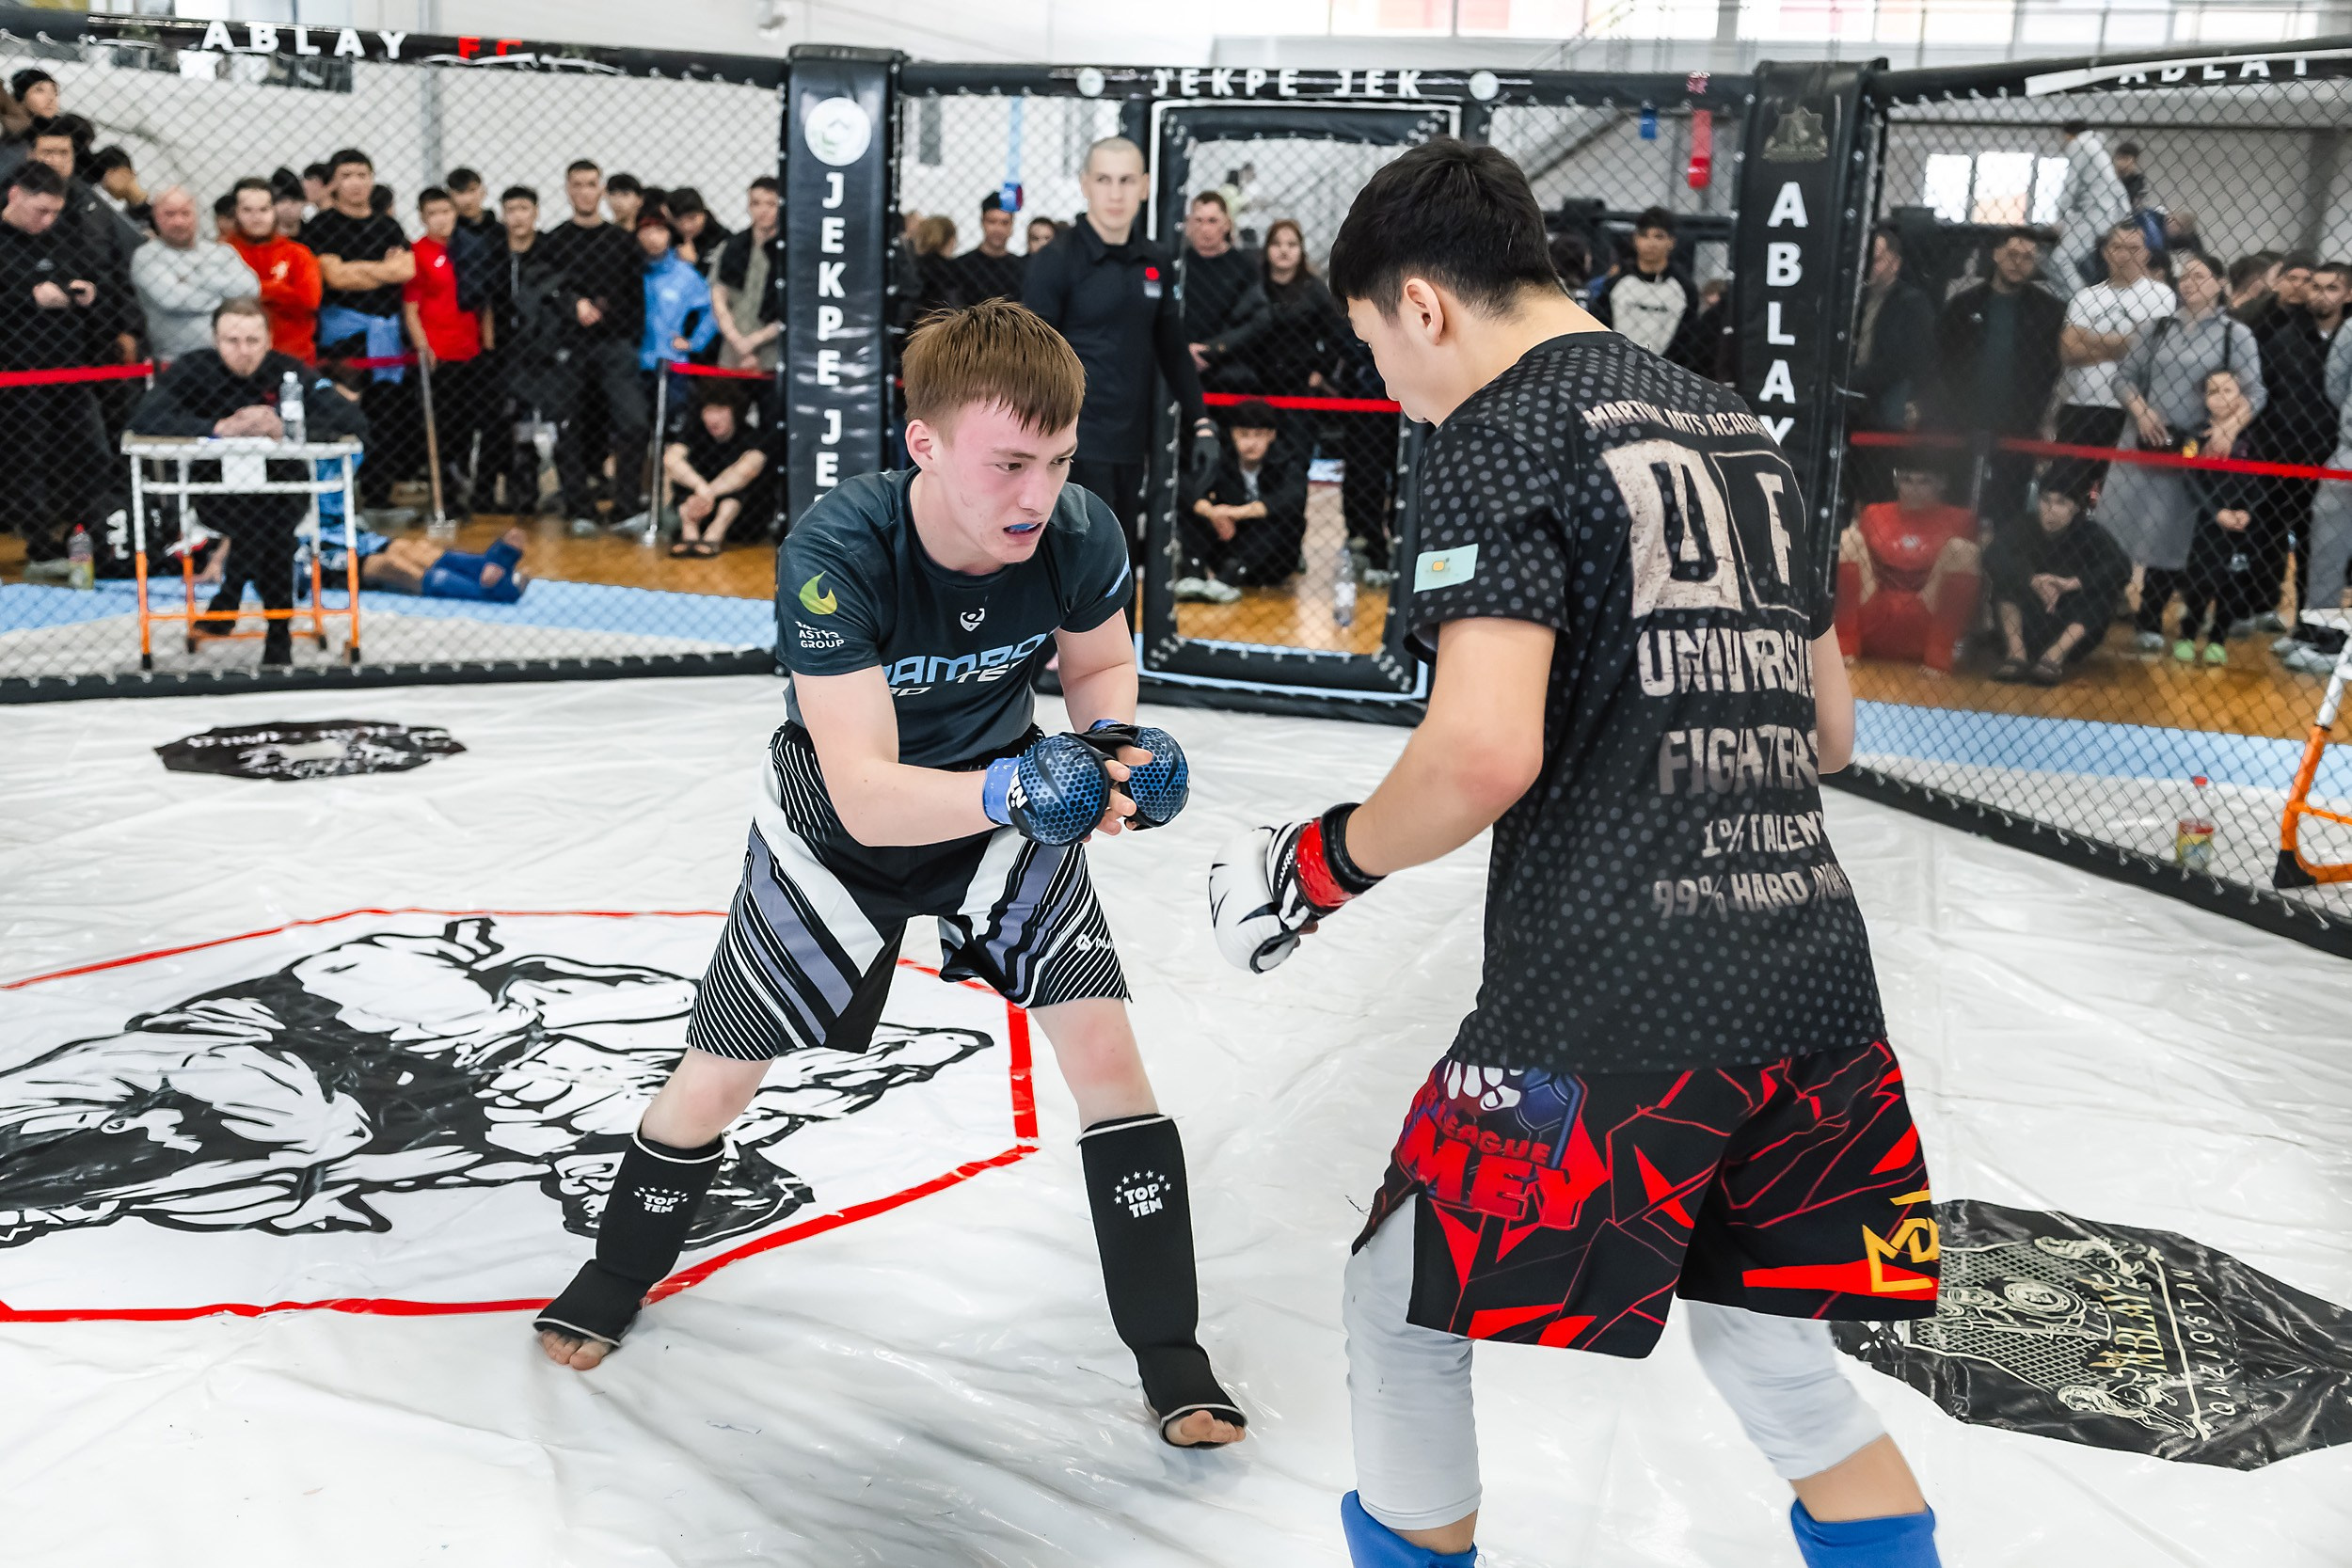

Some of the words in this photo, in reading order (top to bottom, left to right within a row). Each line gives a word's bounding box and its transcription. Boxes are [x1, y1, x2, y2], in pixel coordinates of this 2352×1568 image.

[200, 20, 406, 60] ABLAY
[1151, 68, 1298, 97] JEKPE
[1334, 68, 1423, 97] JEK
[817, 171, 847, 387] JEKPE
[1758, 182, 1809, 447] ABLAY
[1663, 408, 1708, 436] ARTS
[814, 408, 843, 502] JE
[800, 639, 845, 649] GROUP
[1652, 875, 1729, 923] 99%
[1730, 871, 1809, 912] HARD
[1436, 1101, 1551, 1165] LEAGUE
[644, 1194, 679, 1206] TOP
[644, 1201, 675, 1213] TEN
[1123, 1183, 1160, 1204] TOP
[1128, 1196, 1164, 1218] TEN
